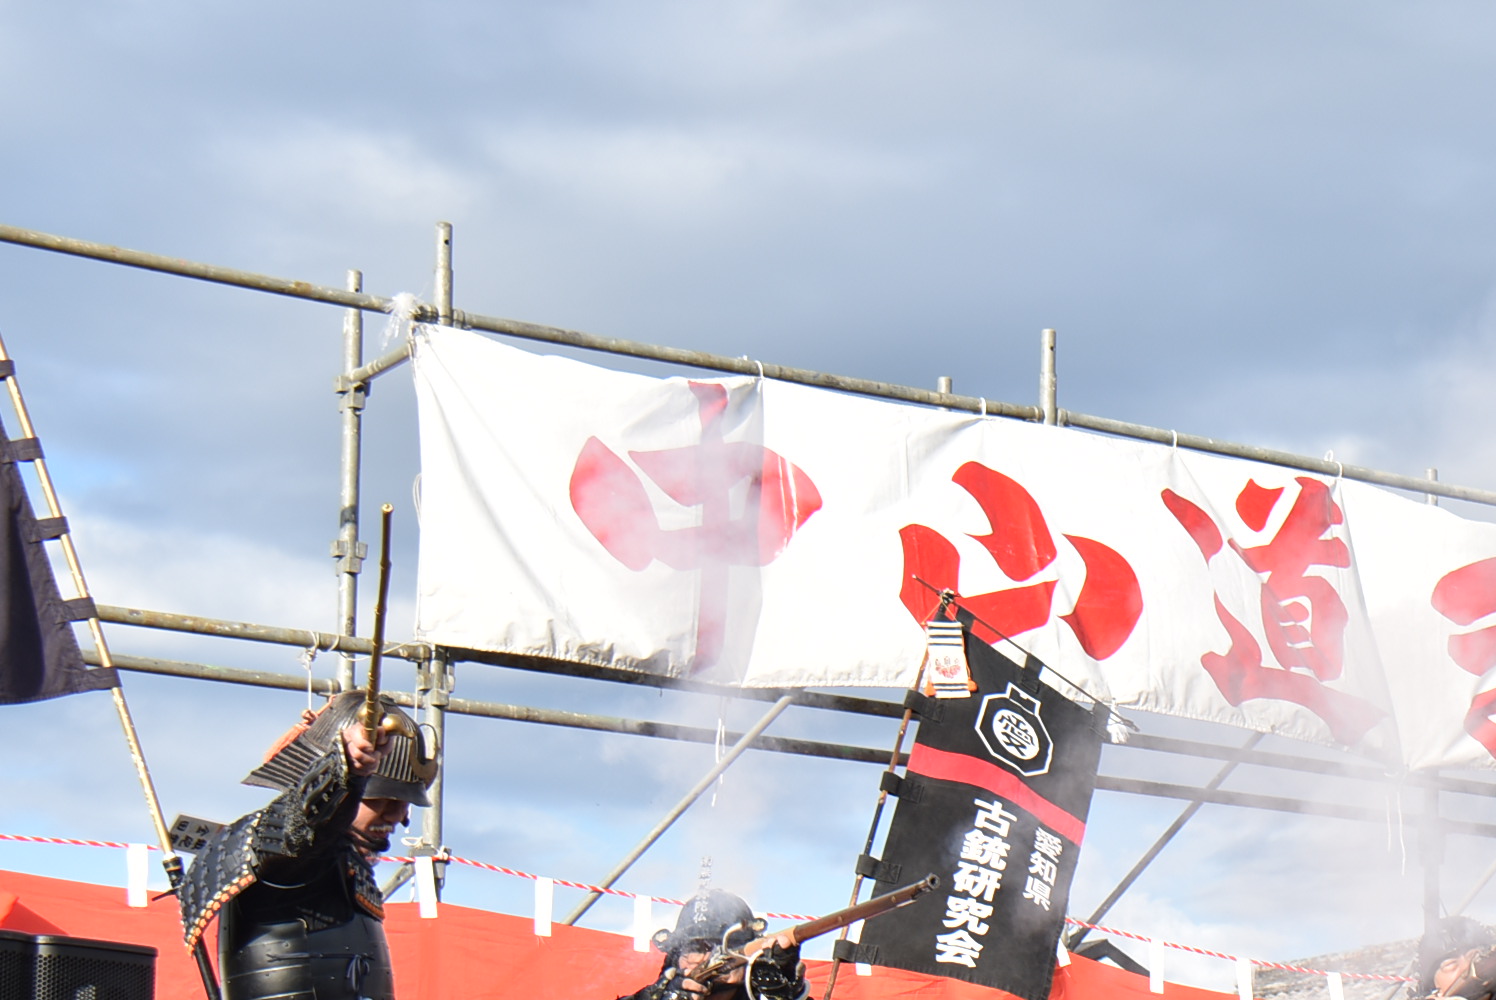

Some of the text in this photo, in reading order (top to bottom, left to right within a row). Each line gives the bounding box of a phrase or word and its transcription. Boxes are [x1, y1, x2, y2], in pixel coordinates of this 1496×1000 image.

[935, 798, 1018, 969] 古銃研究会
[1022, 826, 1063, 911] 愛知県
